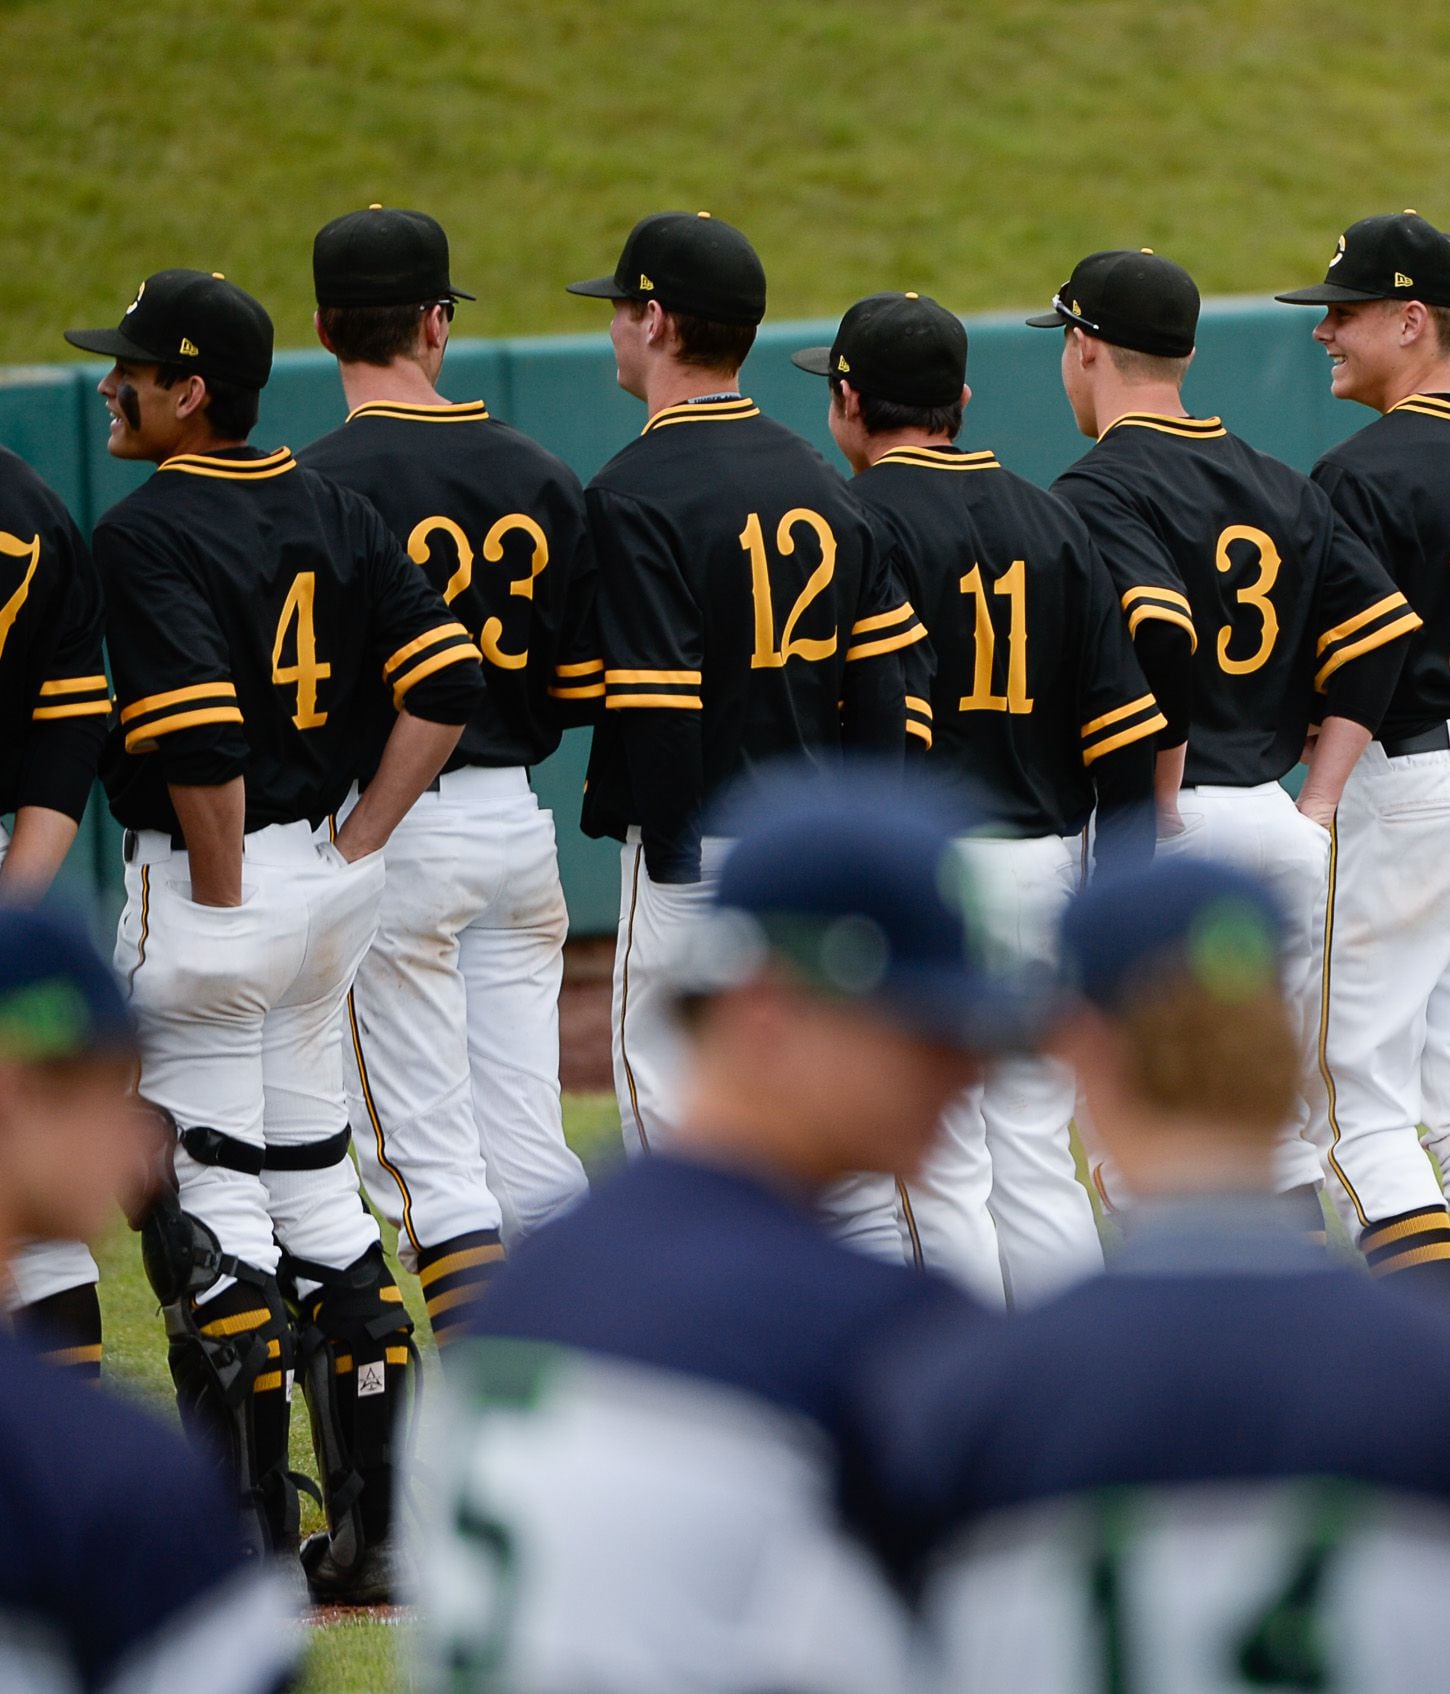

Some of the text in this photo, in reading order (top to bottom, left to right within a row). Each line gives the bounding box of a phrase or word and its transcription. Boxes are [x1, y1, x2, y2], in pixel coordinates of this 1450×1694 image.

[271, 571, 332, 731] 4
[738, 506, 838, 670] 12
[958, 559, 1035, 716] 11
[1214, 523, 1283, 675] 3
